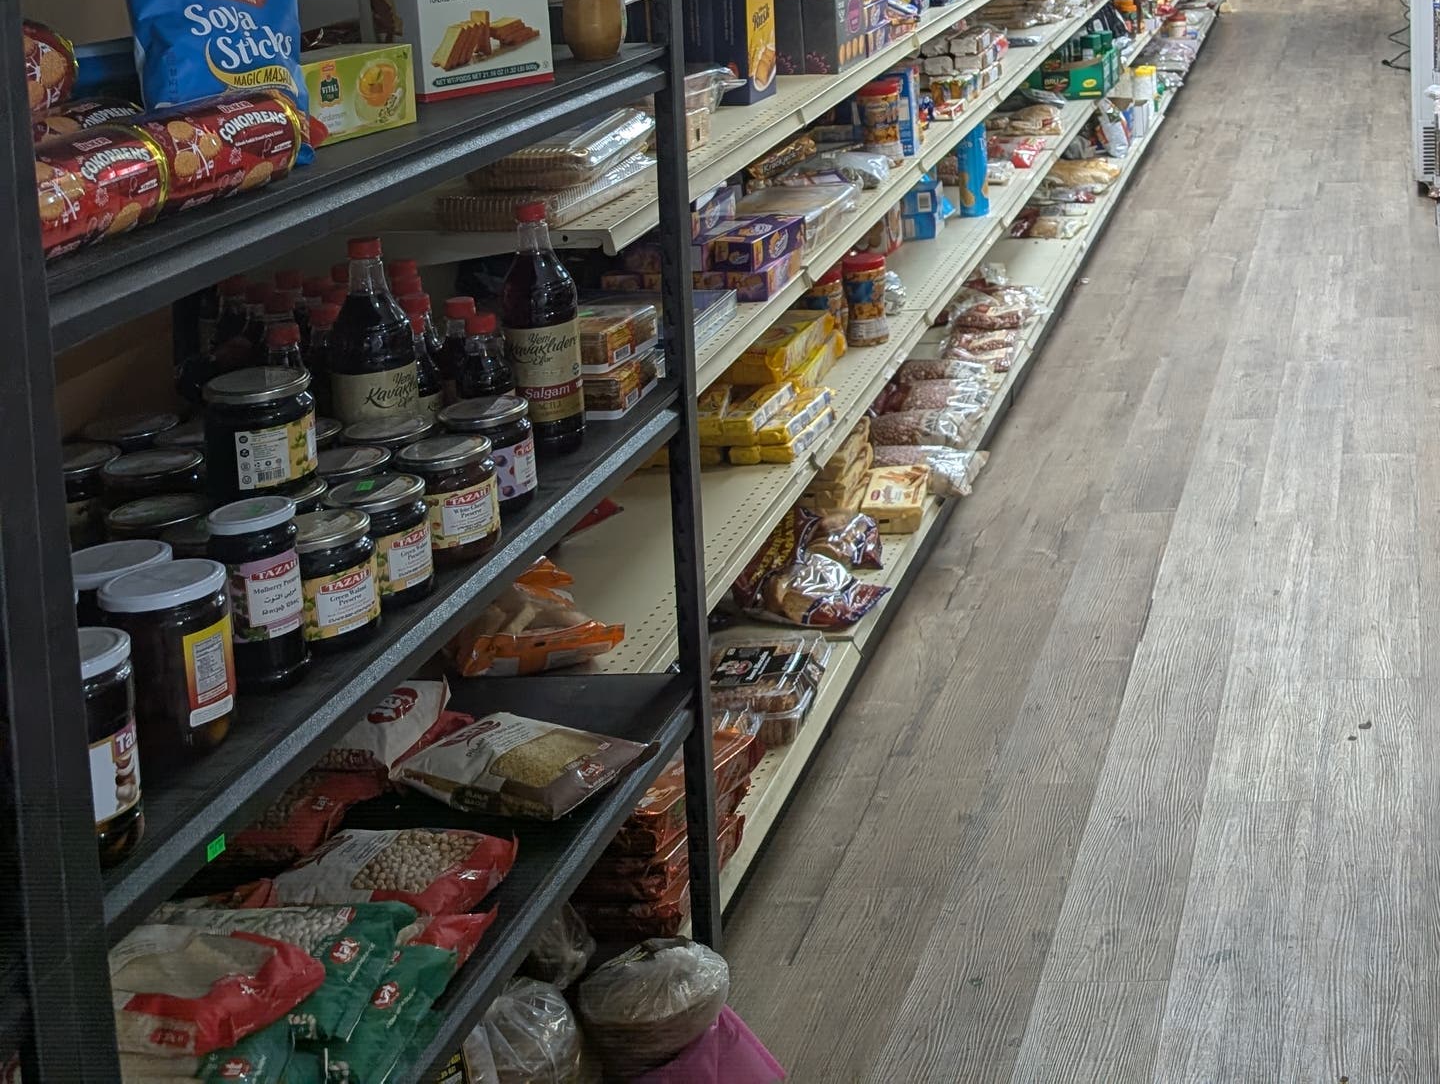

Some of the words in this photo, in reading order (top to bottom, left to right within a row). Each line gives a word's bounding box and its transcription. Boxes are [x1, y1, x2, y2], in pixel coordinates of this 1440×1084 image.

[183, 3, 259, 37] Soya
[751, 4, 770, 30] Rusk
[215, 25, 293, 69] Sticks
[233, 70, 263, 87] MAGIC
[321, 83, 339, 94] VITAL
[528, 332, 552, 347] Yeni
[451, 484, 490, 506] TAZAH
[325, 567, 371, 592] TAZAH
[253, 583, 283, 596] Mulberry
[329, 591, 350, 603] Green
[338, 593, 363, 607] Preserve
